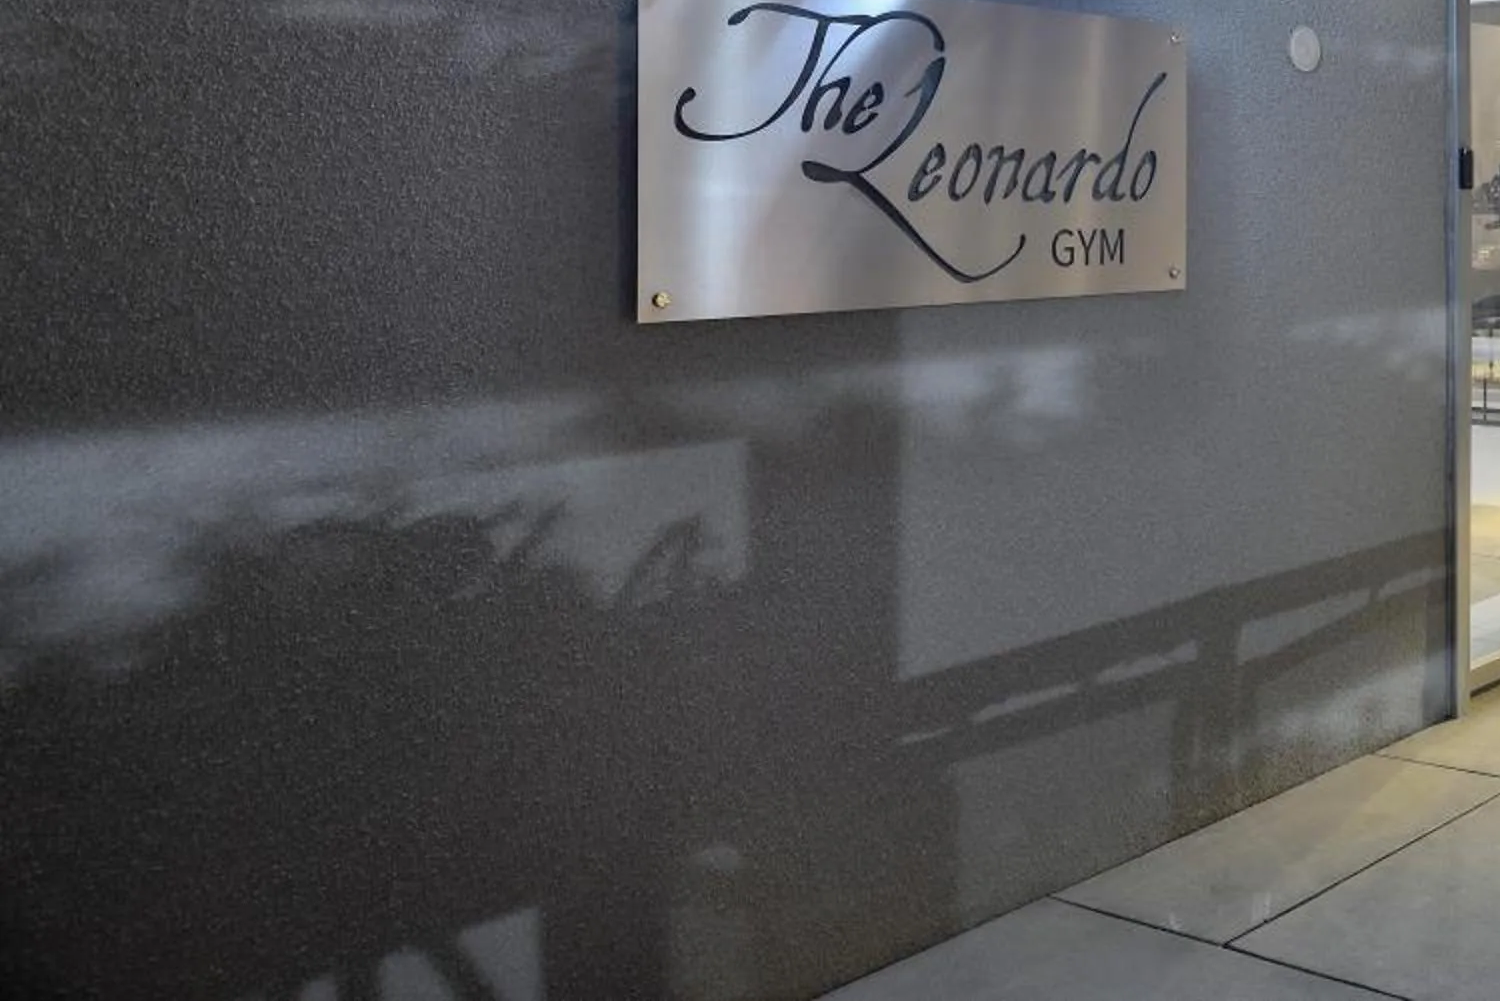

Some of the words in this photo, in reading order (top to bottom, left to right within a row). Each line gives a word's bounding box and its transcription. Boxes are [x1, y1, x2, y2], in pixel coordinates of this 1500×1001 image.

[674, 2, 945, 142] The
[802, 55, 1168, 283] Leonardo
[1050, 227, 1126, 267] GYM
